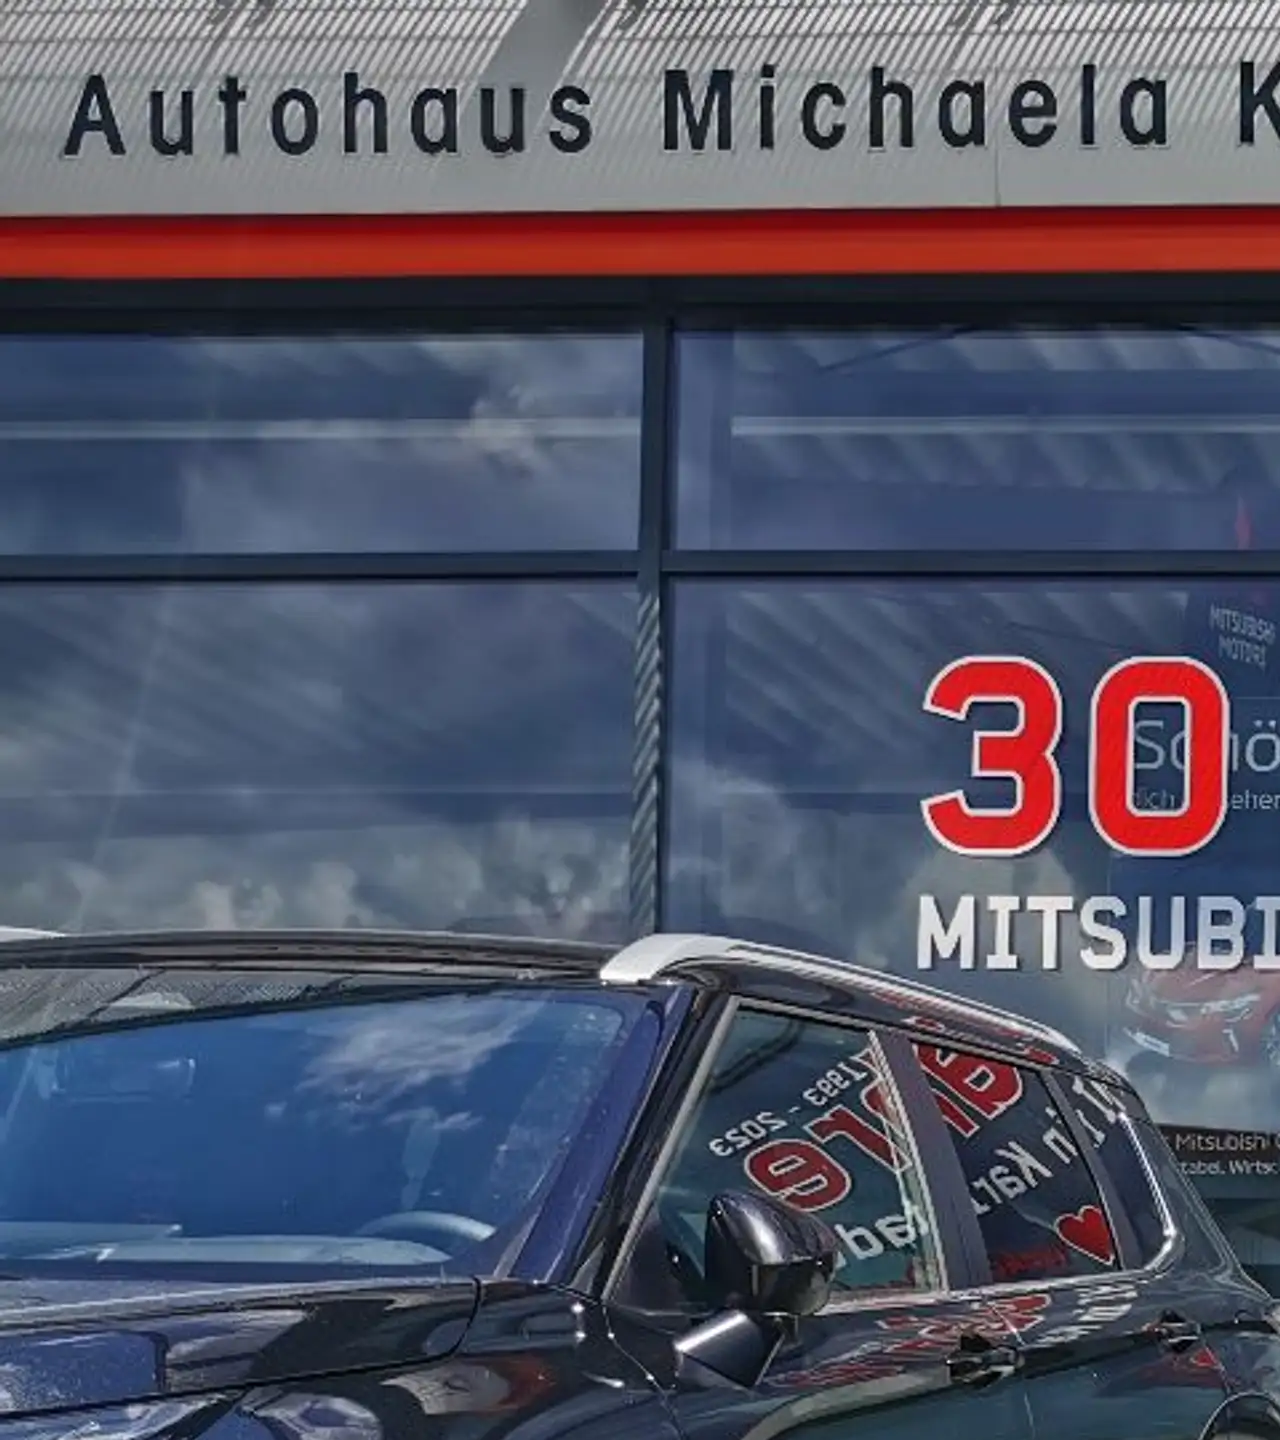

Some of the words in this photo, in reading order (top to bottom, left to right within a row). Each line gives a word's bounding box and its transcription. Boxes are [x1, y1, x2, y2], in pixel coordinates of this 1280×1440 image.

[64, 71, 593, 157] Autohaus
[664, 64, 1169, 152] Michaela
[920, 655, 1230, 858] 30
